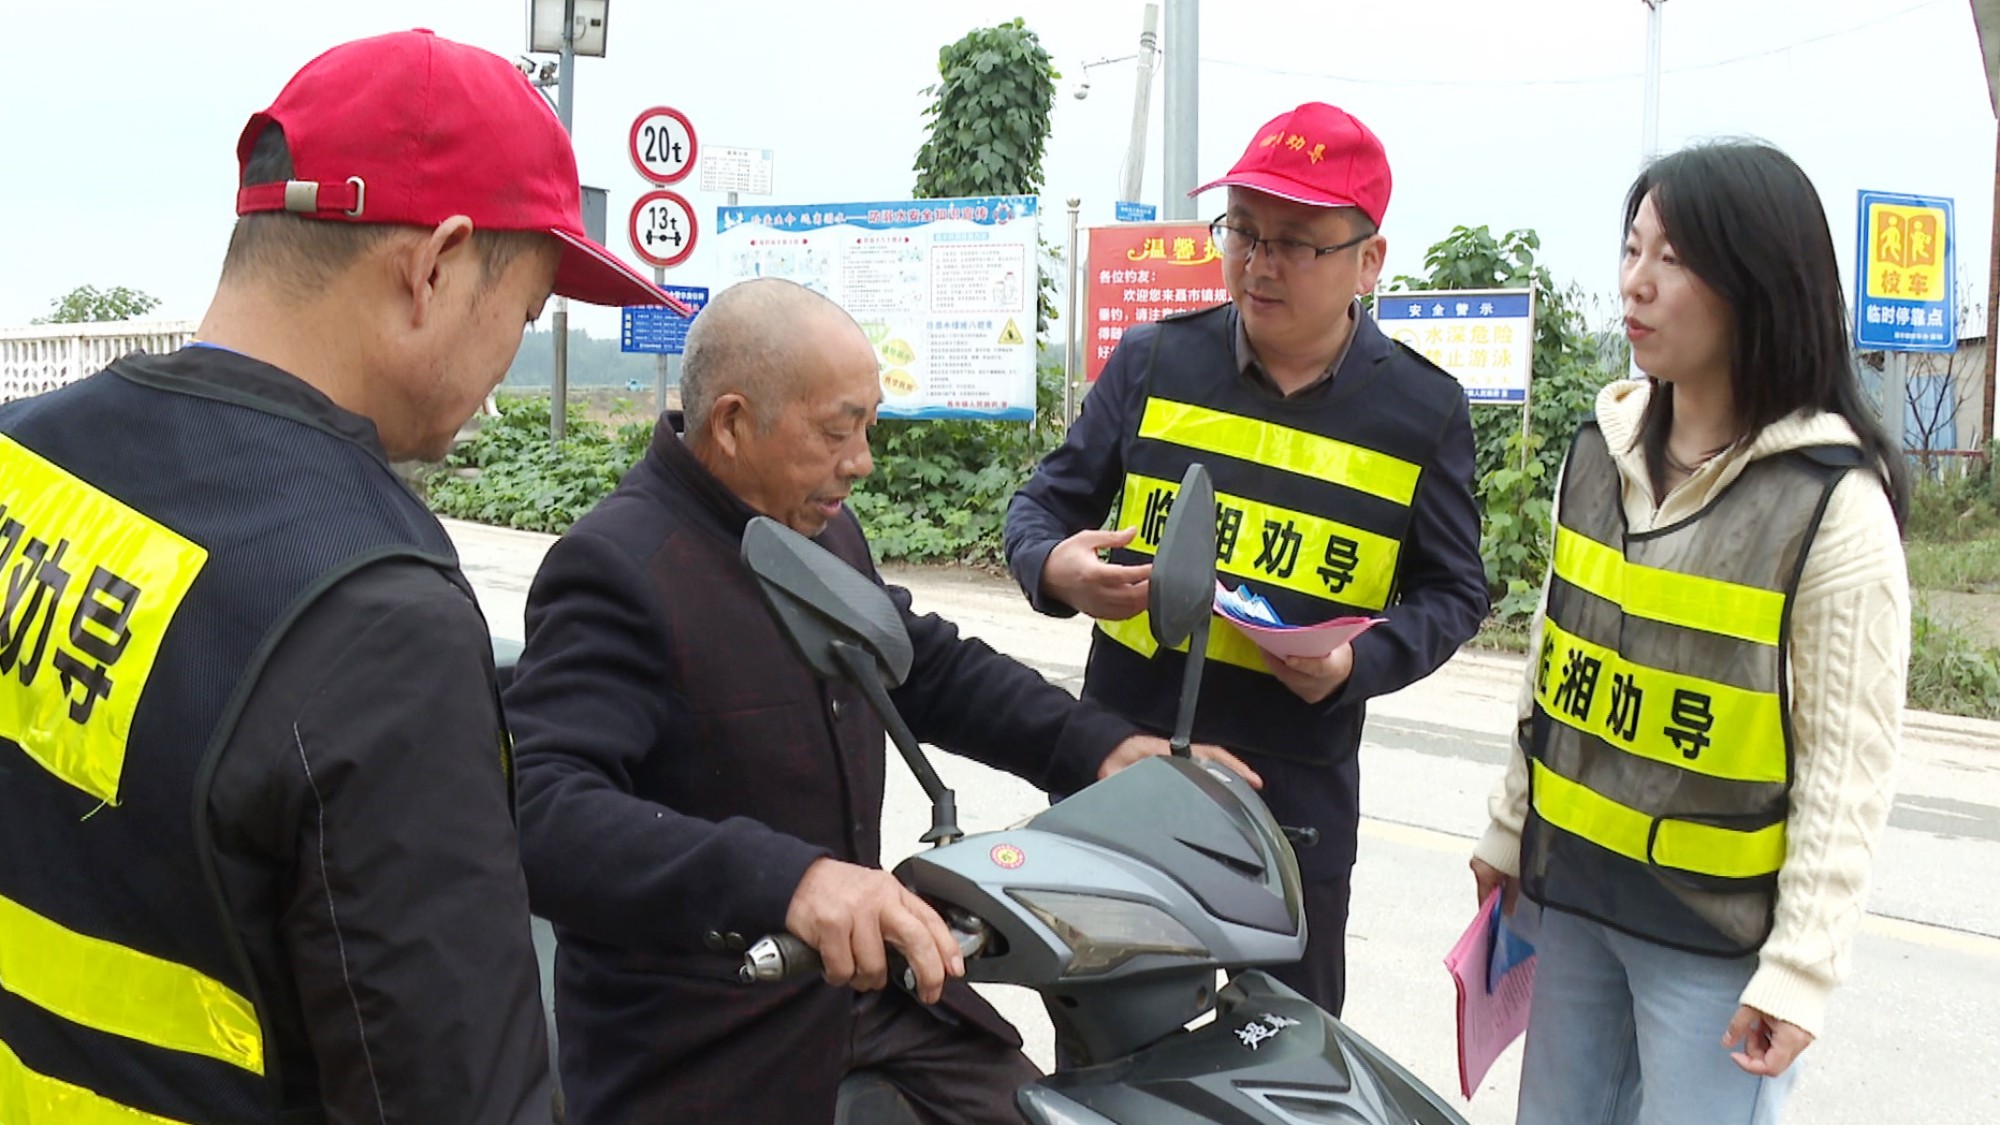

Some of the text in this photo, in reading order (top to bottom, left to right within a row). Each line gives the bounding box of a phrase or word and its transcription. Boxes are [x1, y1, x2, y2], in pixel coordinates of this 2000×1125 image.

[645, 126, 682, 162] 20t
[649, 206, 678, 230] 13t
[1881, 269, 1929, 296] 校车
[1409, 303, 1494, 317] 安全警示
[1866, 304, 1943, 327] 临时停靠点
[1424, 324, 1513, 345] 水深危险
[0, 503, 141, 724] 劝导
